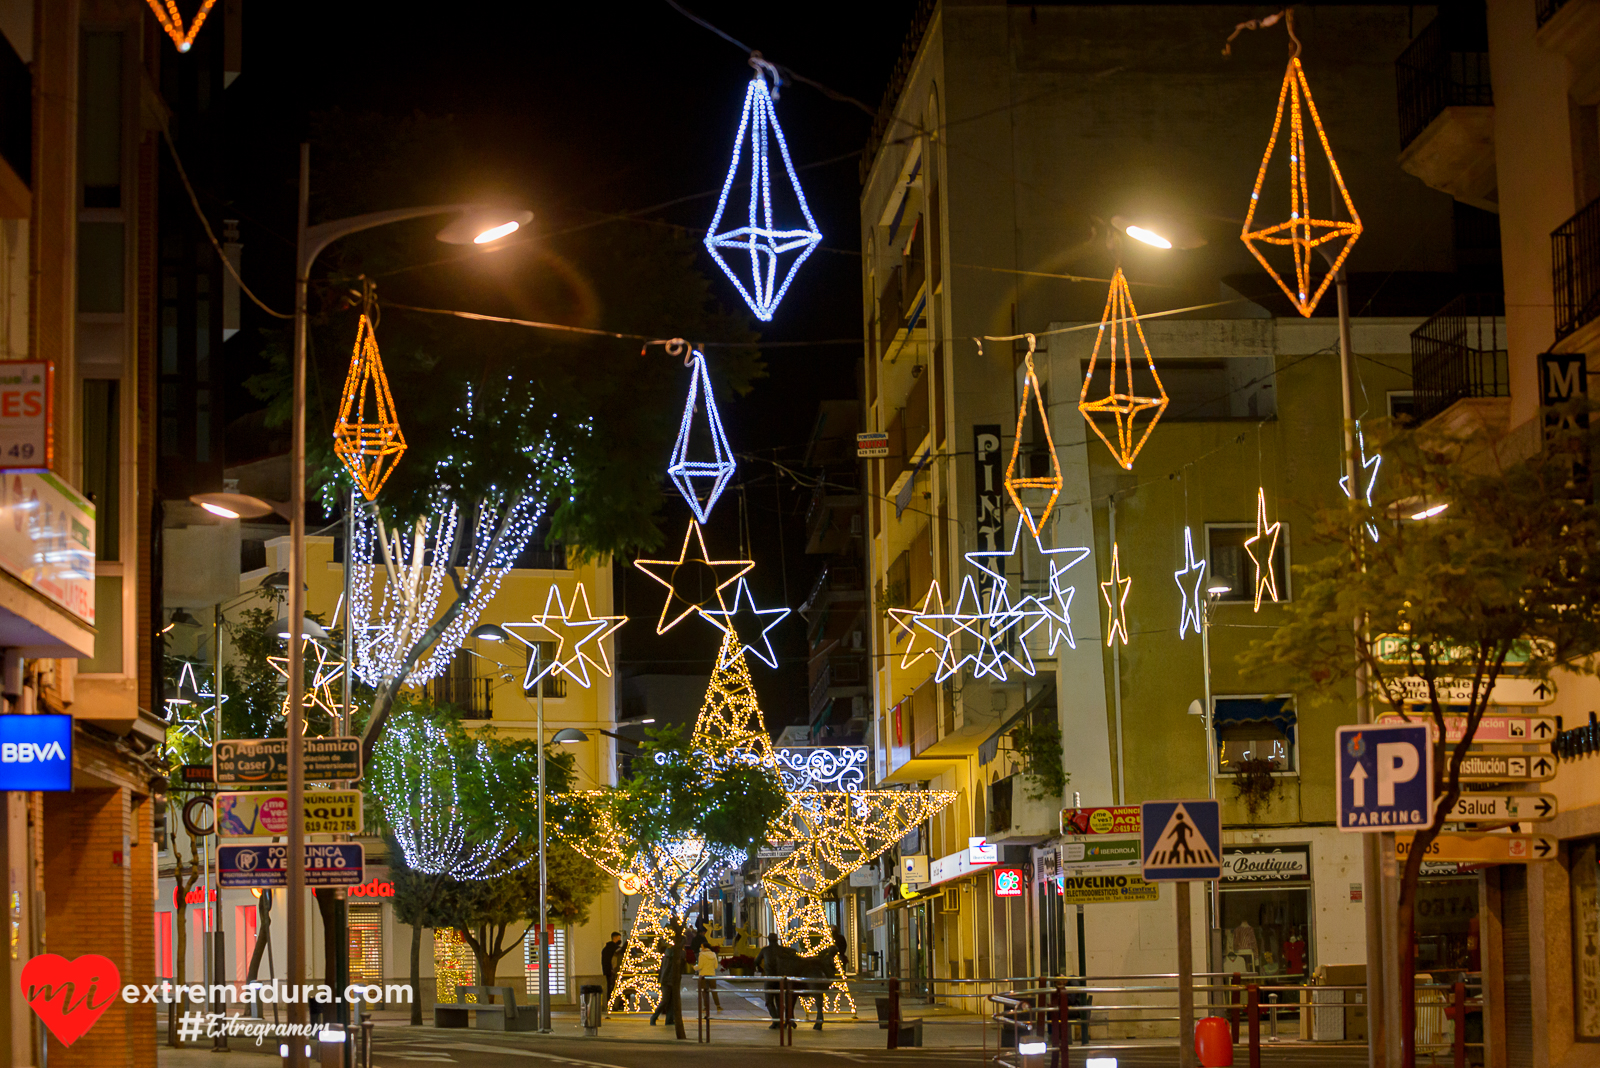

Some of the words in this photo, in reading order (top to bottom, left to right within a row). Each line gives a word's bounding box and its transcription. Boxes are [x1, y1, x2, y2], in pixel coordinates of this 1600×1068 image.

[858, 440, 887, 449] QUINI
[1, 741, 67, 763] BBVA
[219, 761, 235, 771] 100
[237, 760, 267, 771] Caser
[1446, 757, 1507, 774] Cnstitución
[219, 773, 235, 781] mts
[1376, 741, 1420, 806] P
[1458, 800, 1496, 815] Salud
[1348, 810, 1420, 826] PARKING
[305, 821, 321, 832] 619
[323, 821, 339, 831] 472
[1100, 847, 1136, 855] IBERDROLA
[1233, 855, 1303, 874] Boutique
[1065, 875, 1128, 889] AVELINO
[1066, 888, 1119, 898] ELECTRODOMESTICOS
